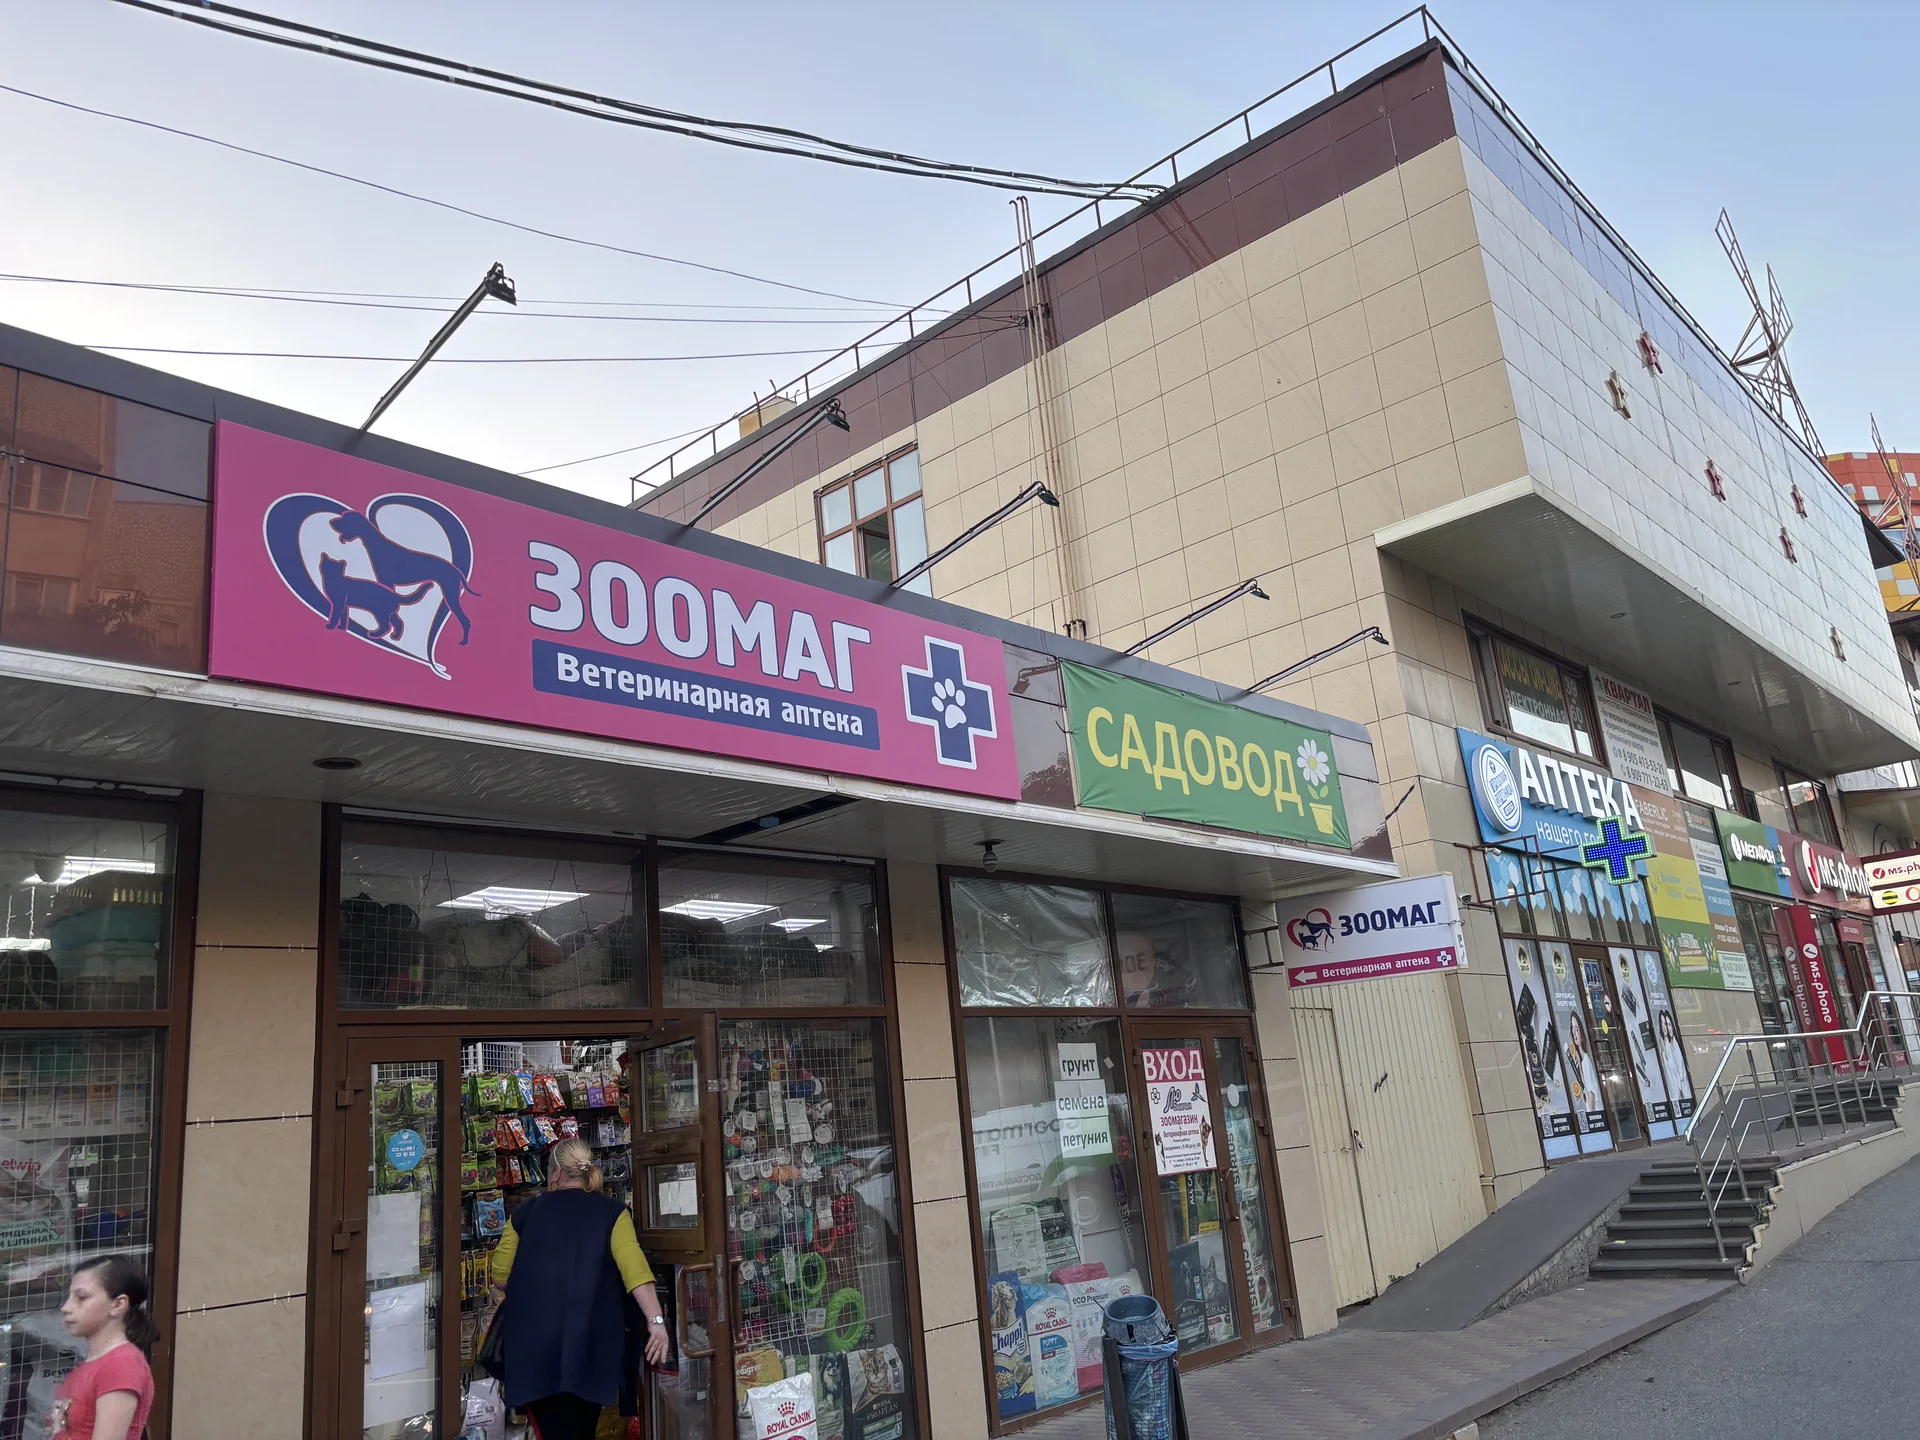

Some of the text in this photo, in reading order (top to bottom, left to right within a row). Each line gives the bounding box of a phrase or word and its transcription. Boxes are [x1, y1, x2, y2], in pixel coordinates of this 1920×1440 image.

[527, 539, 871, 693] ЗООМАГ
[557, 652, 863, 736] Ветеринарная аптека
[1602, 676, 1651, 714] КВАРТАЛ
[1086, 706, 1305, 817] САДОВОД
[1518, 747, 1645, 831] АПТЕКА
[1338, 900, 1441, 937] ЗООМАГ
[1322, 956, 1430, 979] Ветеринарная аптека
[1062, 1057, 1095, 1076] грунт
[1142, 1050, 1205, 1081] ВХОД
[1058, 1095, 1105, 1111] семена
[1160, 1114, 1199, 1127] зоомагазин
[1062, 1130, 1108, 1149] петуния
[1035, 1320, 1051, 1332] ROYAL
[766, 1409, 811, 1435] ROYAL CANIN
